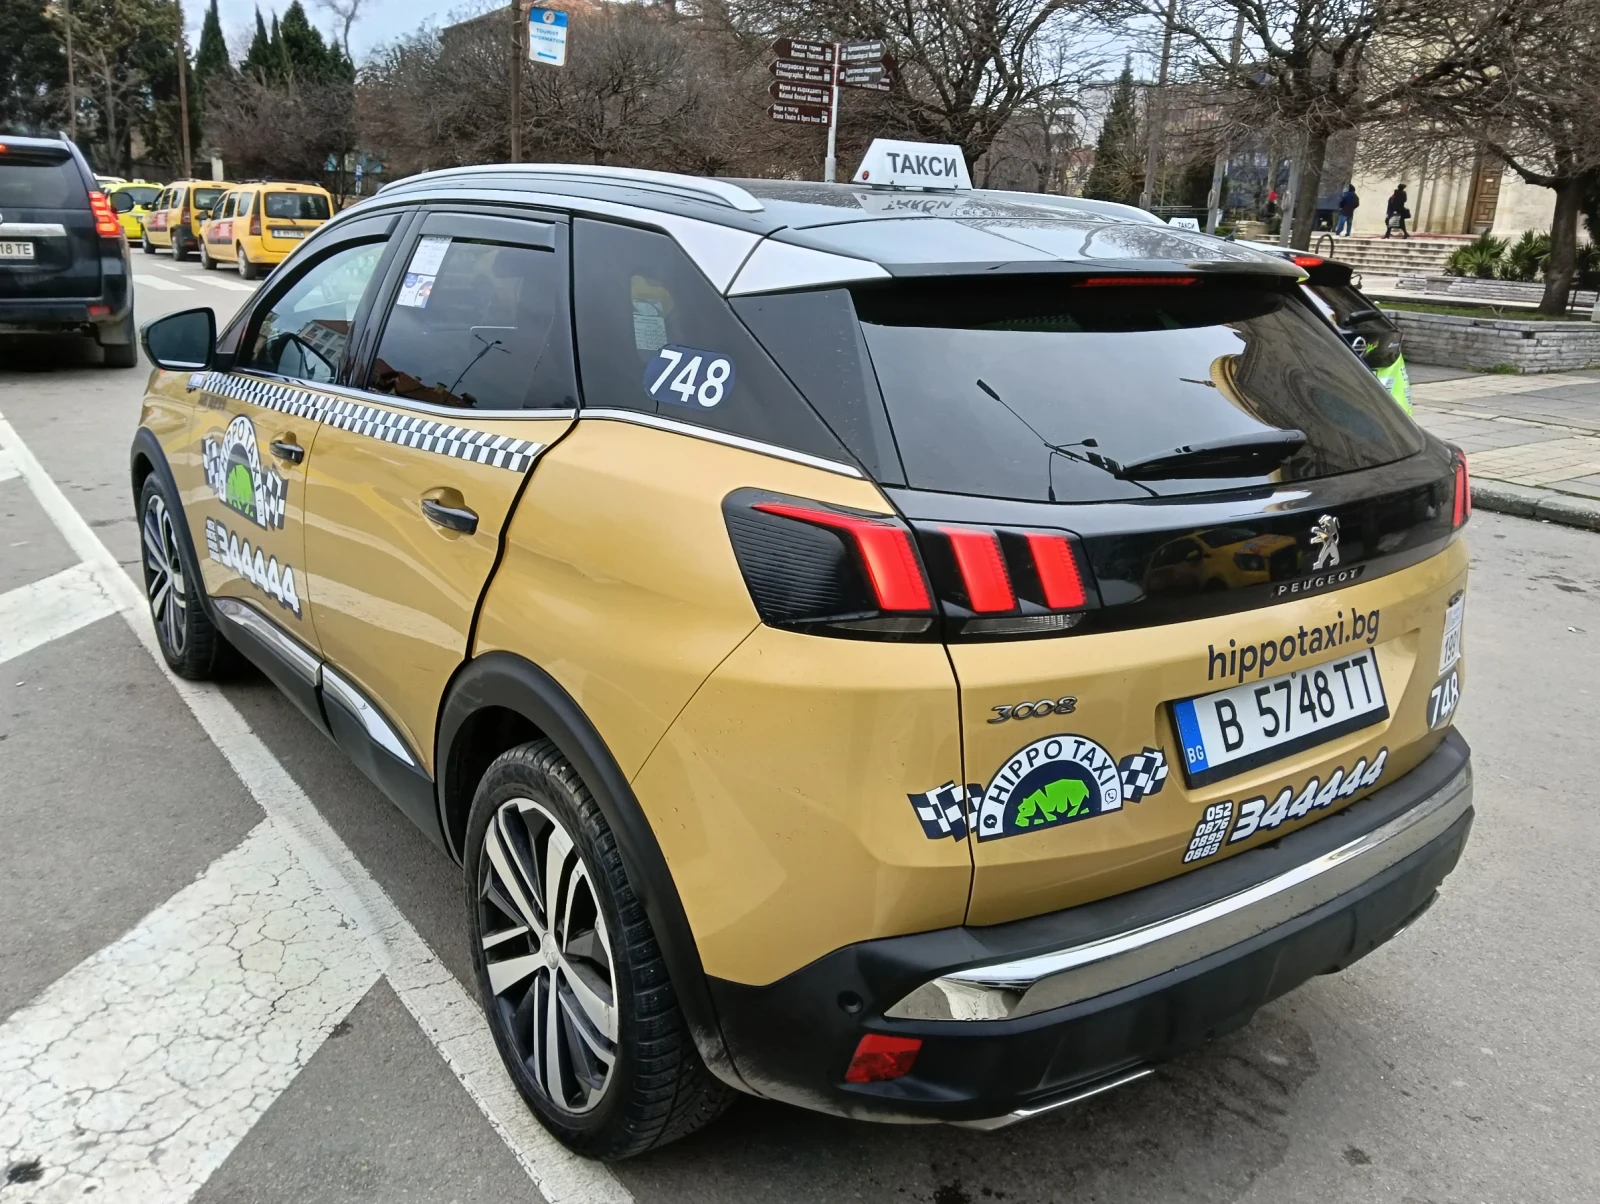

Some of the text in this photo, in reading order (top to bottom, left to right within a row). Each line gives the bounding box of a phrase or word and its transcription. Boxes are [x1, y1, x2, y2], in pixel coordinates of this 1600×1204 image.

[531, 34, 564, 44] ORMATION
[536, 28, 559, 36] TOURIST
[776, 69, 804, 79] Ethnographic
[886, 152, 958, 178] ТАКСИ
[15, 244, 31, 255] TE
[649, 348, 732, 408] 748
[216, 525, 299, 613] 344444
[1278, 568, 1357, 596] PEUGEOT
[1208, 608, 1380, 681] hippotaxi.bg
[986, 696, 1078, 724] 3008
[1217, 656, 1374, 752] B 5748 TT
[1431, 672, 1459, 729] 748
[1188, 747, 1204, 764] BG
[988, 739, 1116, 806] HIPPO TAXI
[1231, 750, 1388, 842] 344444
[1206, 802, 1233, 820] 052
[1190, 830, 1225, 850] 0899
[1196, 819, 1229, 836] 0876
[1184, 844, 1218, 862] 0883
